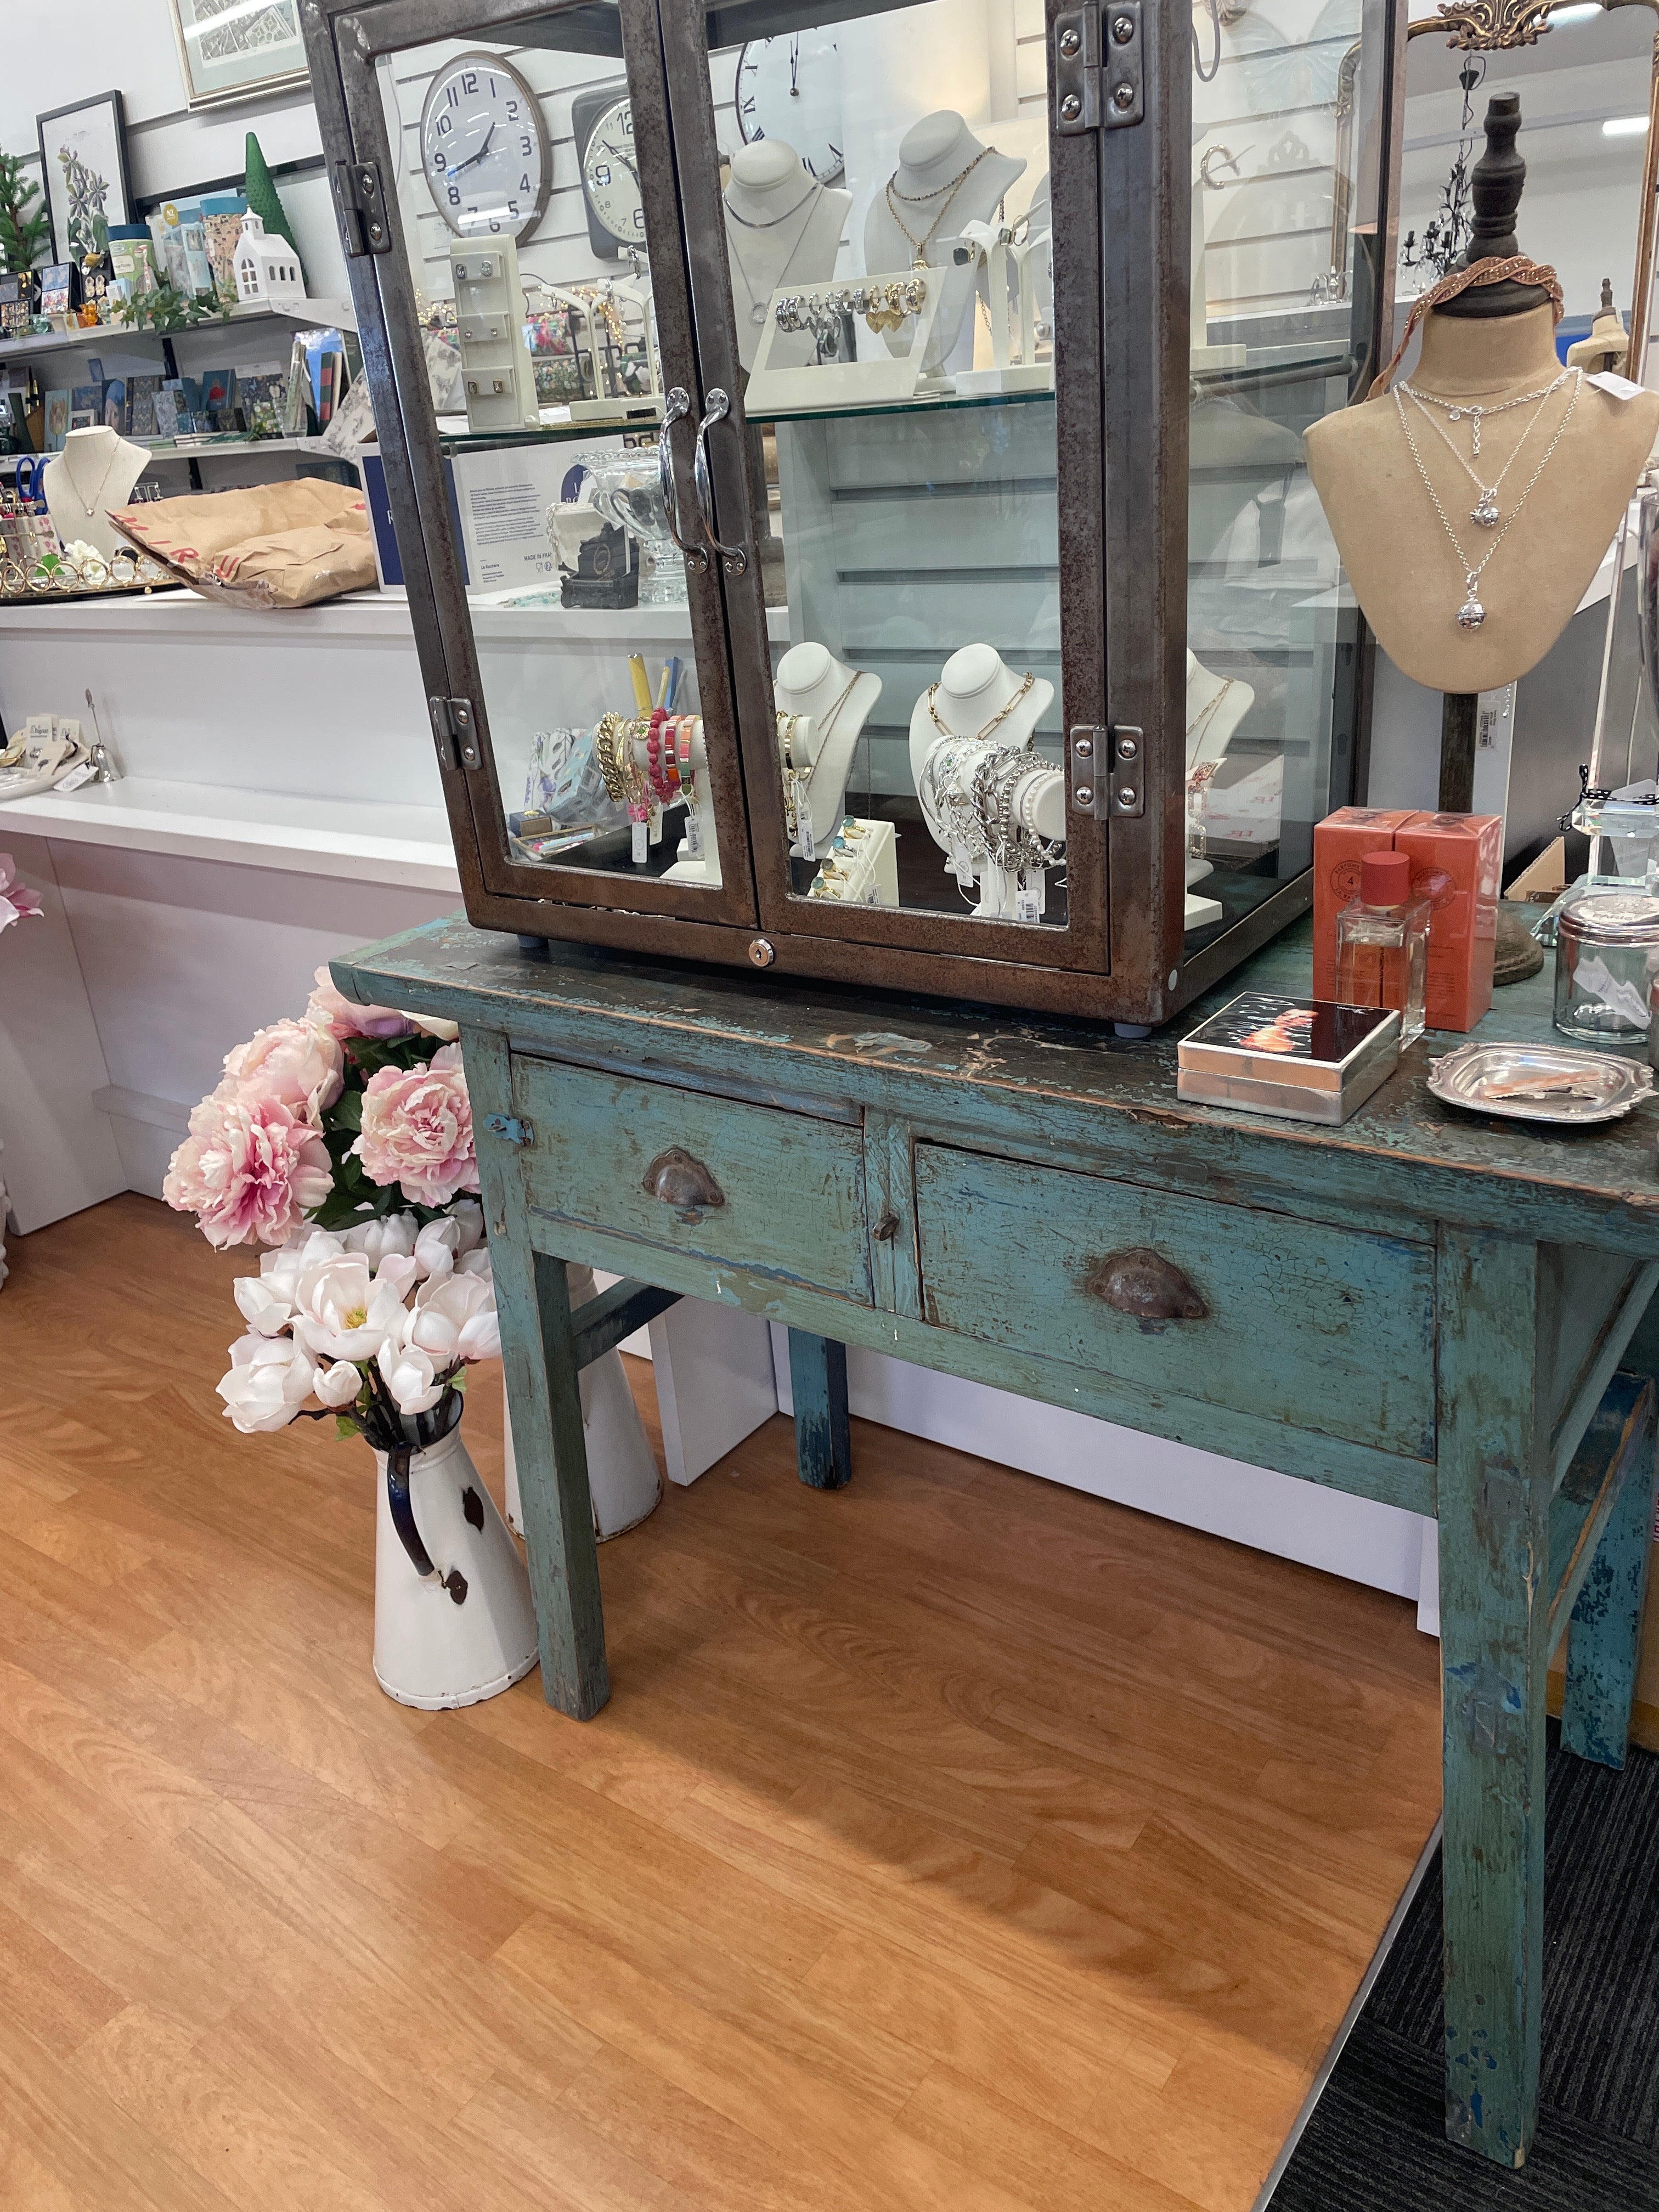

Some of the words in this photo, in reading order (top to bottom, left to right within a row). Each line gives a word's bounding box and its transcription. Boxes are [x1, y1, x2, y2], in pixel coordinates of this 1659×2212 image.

[461, 72, 479, 94] 12
[489, 77, 496, 98] 1
[446, 86, 459, 108] 11
[506, 100, 520, 121] 2
[435, 114, 452, 136] 10
[520, 136, 532, 156] 3
[434, 152, 447, 172] 9
[519, 173, 531, 193] 4
[595, 165, 612, 186] 9
[447, 186, 461, 206] 8
[507, 200, 520, 220] 5
[621, 218, 627, 226] 7
[1347, 876, 1354, 885] 4
[1592, 913, 1633, 921] PARIS
